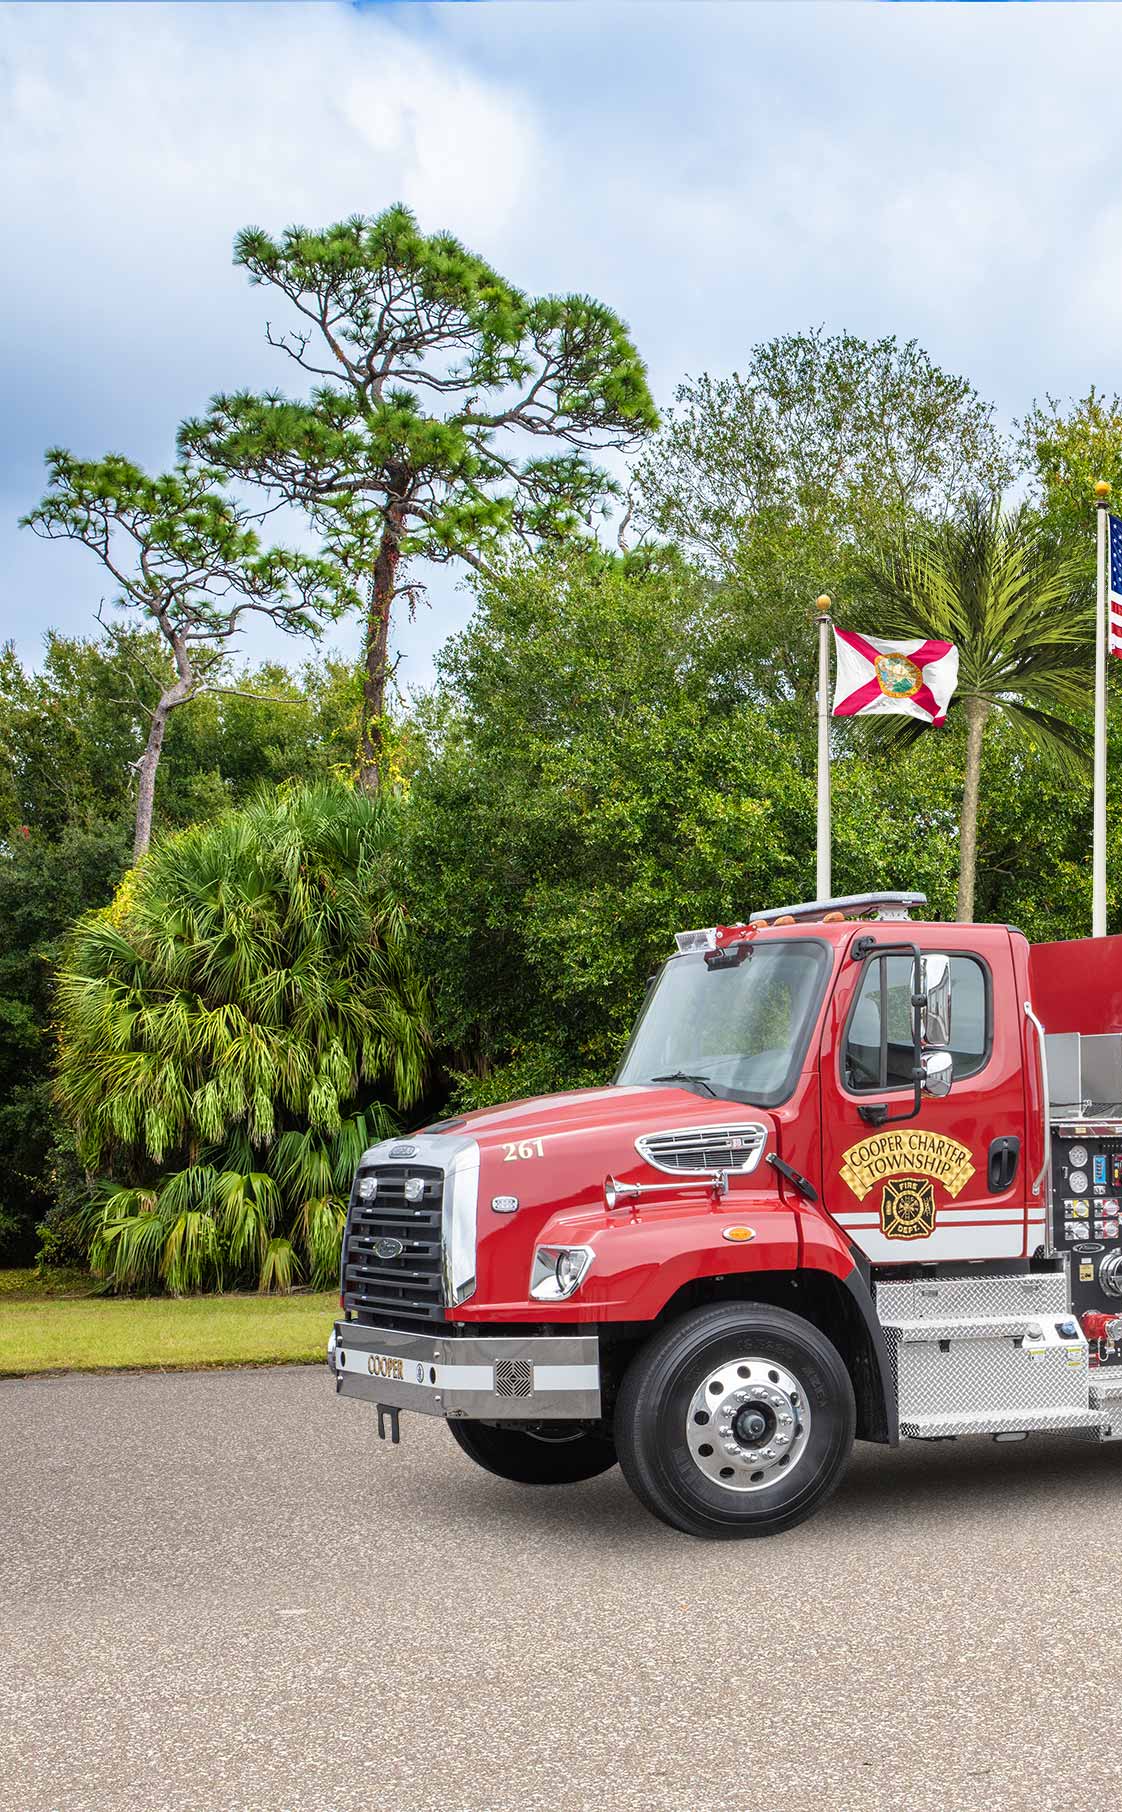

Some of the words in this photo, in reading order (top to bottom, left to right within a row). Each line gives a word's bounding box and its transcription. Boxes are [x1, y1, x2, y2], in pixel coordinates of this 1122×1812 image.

[503, 1139, 545, 1162] 261
[850, 1135, 903, 1167] COOPER
[908, 1134, 966, 1166] CHARTER
[864, 1153, 952, 1178] TOWNSHIP
[899, 1182, 918, 1190] FIRE
[897, 1224, 920, 1234] DEPT.
[367, 1355, 404, 1380] COOPER
